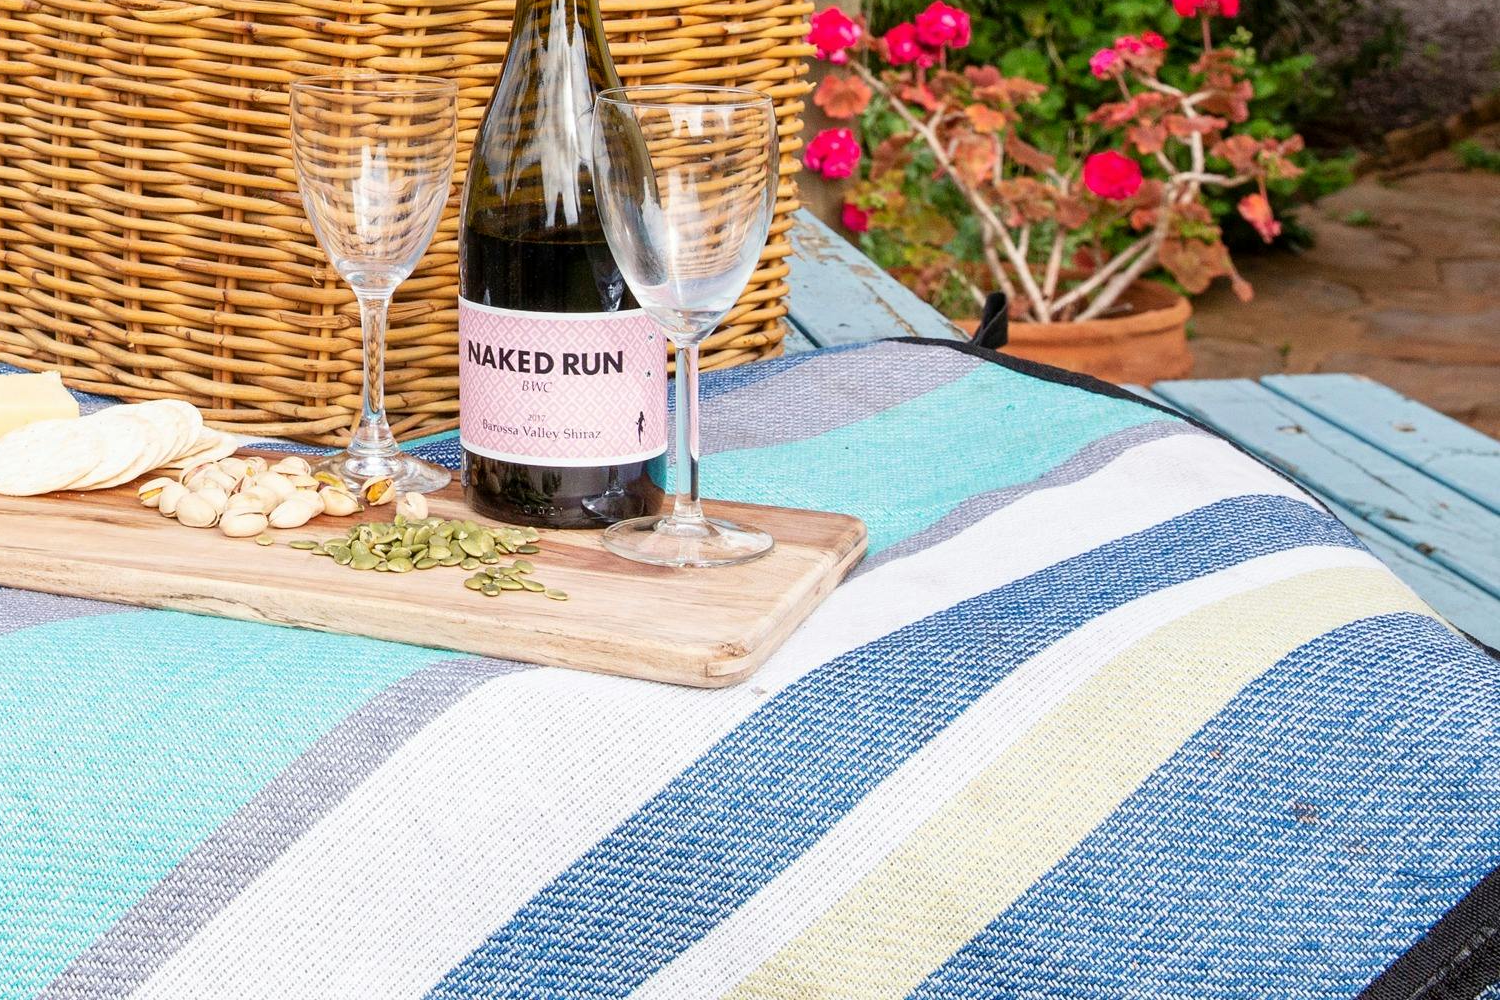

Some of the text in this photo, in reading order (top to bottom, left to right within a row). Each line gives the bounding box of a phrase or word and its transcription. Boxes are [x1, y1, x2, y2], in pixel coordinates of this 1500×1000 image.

[468, 340, 623, 376] NAKED RUN
[522, 380, 553, 393] BWC
[482, 418, 602, 441] Barossa Valley Shiraz
